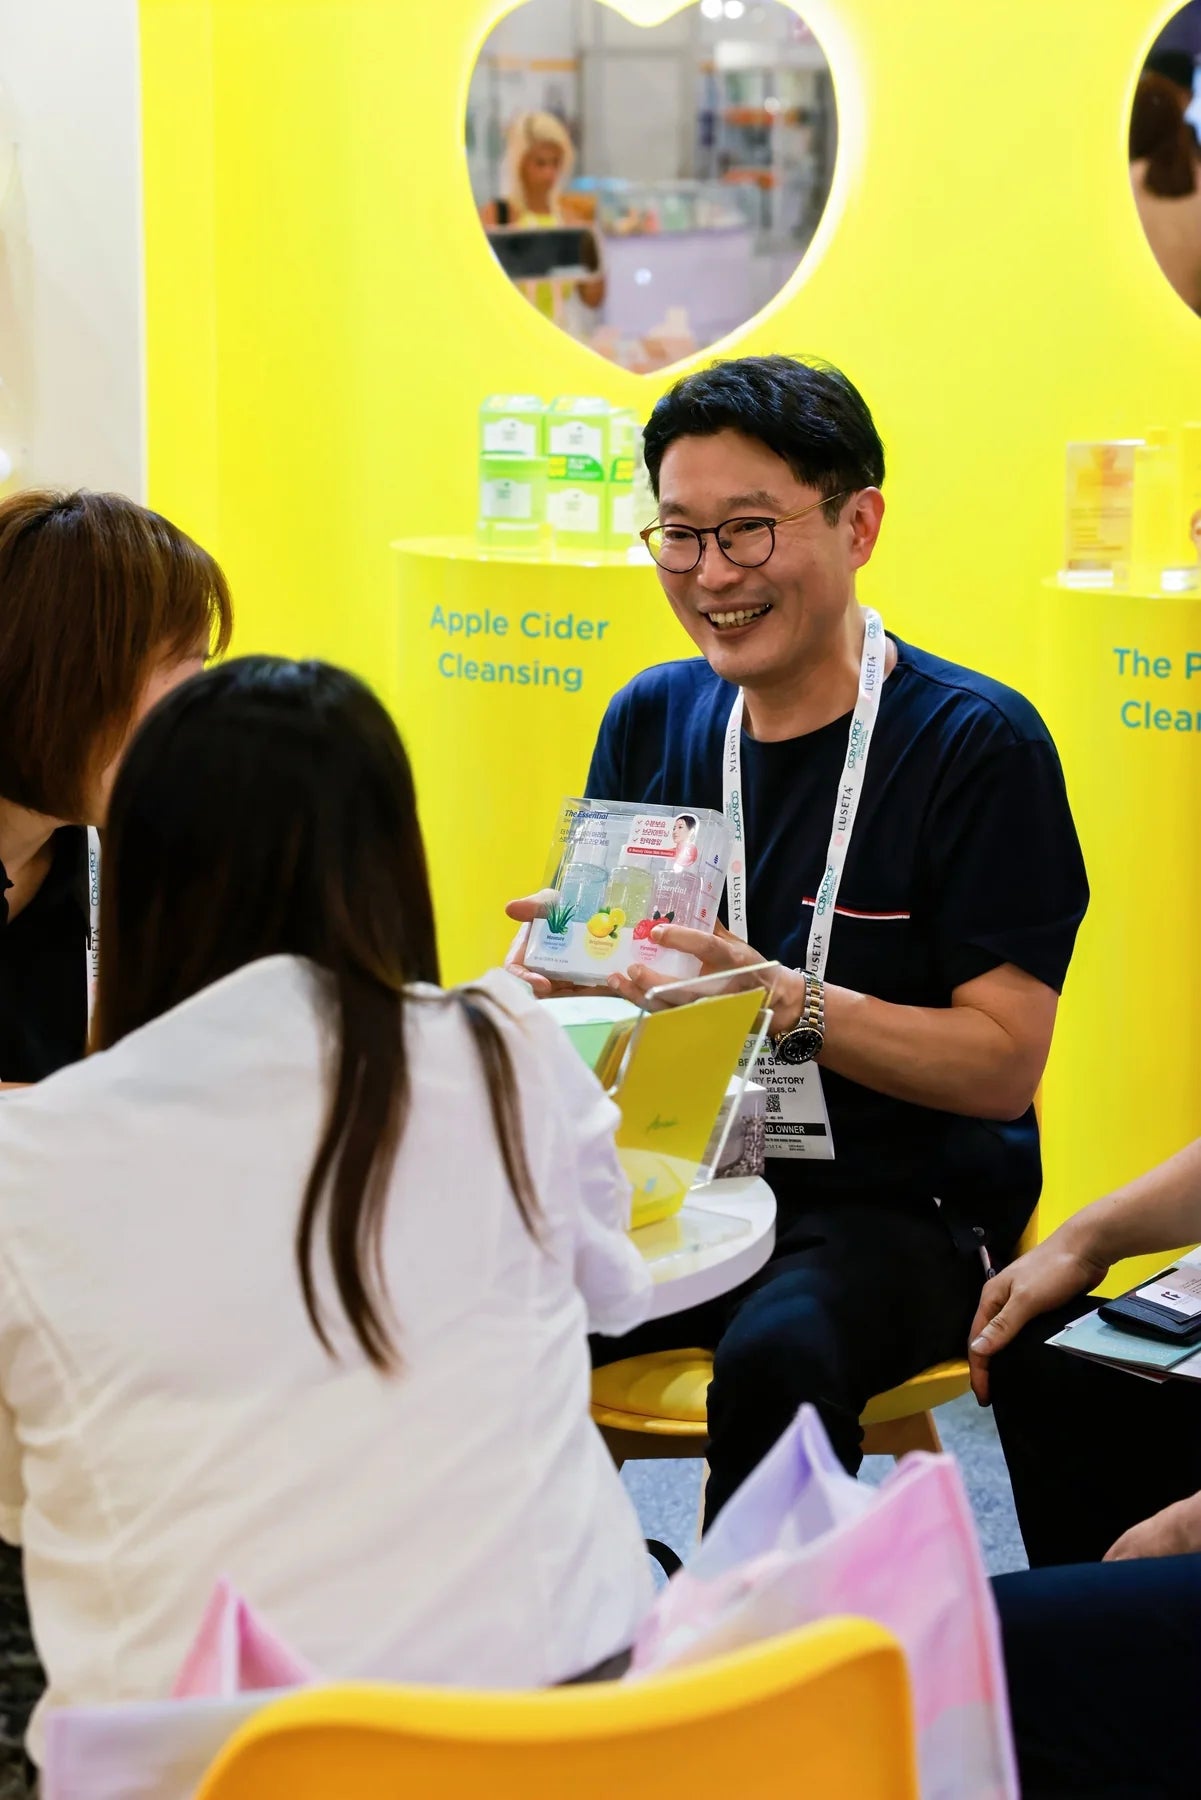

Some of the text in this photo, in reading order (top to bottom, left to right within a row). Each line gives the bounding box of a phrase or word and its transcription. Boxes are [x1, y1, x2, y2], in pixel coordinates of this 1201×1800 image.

[430, 605, 610, 640] Apple Cider
[438, 652, 583, 693] Cleansing
[865, 655, 877, 691] LUSETA
[1113, 648, 1201, 680] The P
[729, 729, 738, 772] LUSETA
[847, 719, 863, 769] COSMOPROF
[565, 809, 609, 820] The Essential
[838, 786, 853, 831] LUSETA
[733, 876, 742, 921] LUSETA
[816, 865, 835, 916] COSMOPROF
[812, 935, 823, 973] USETA
[767, 1077, 805, 1085] FACTORY
[776, 1125, 805, 1134] OWNER
